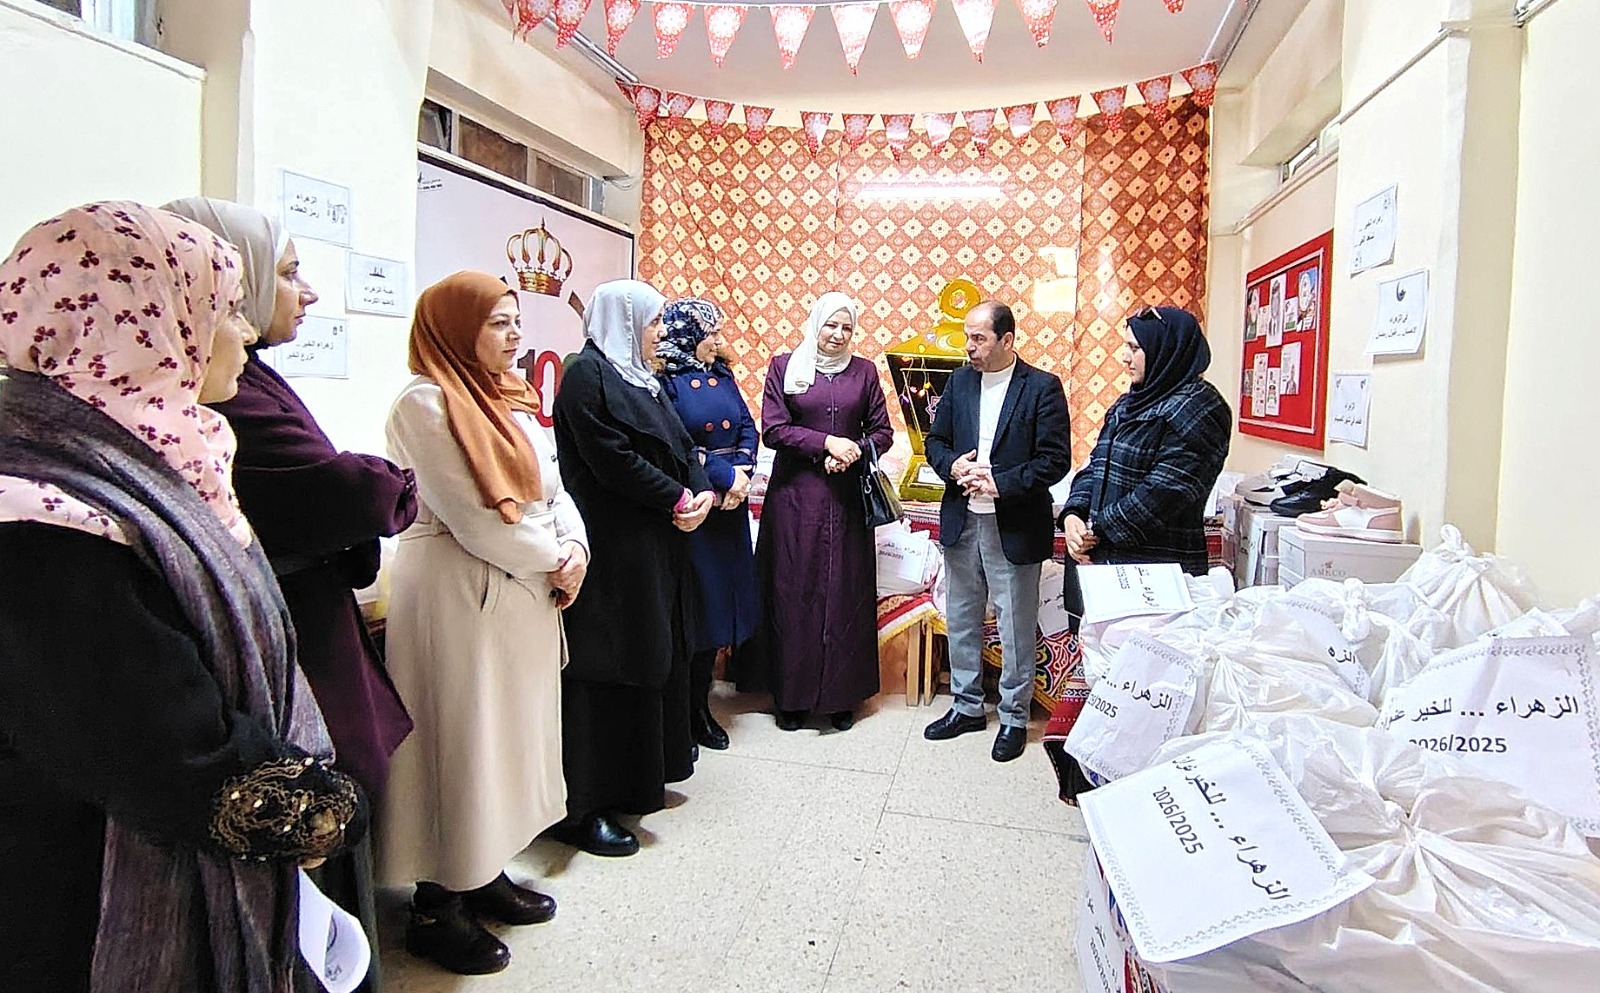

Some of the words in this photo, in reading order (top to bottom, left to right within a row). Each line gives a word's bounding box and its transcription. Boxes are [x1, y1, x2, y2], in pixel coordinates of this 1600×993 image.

[1122, 680, 1173, 710] الزهراء
[1411, 697, 1453, 722] للخير
[1495, 694, 1580, 719] الزهراء
[1185, 774, 1227, 805] للخير
[1152, 786, 1204, 855] 2026/2025
[1227, 835, 1292, 900] الزهراء
